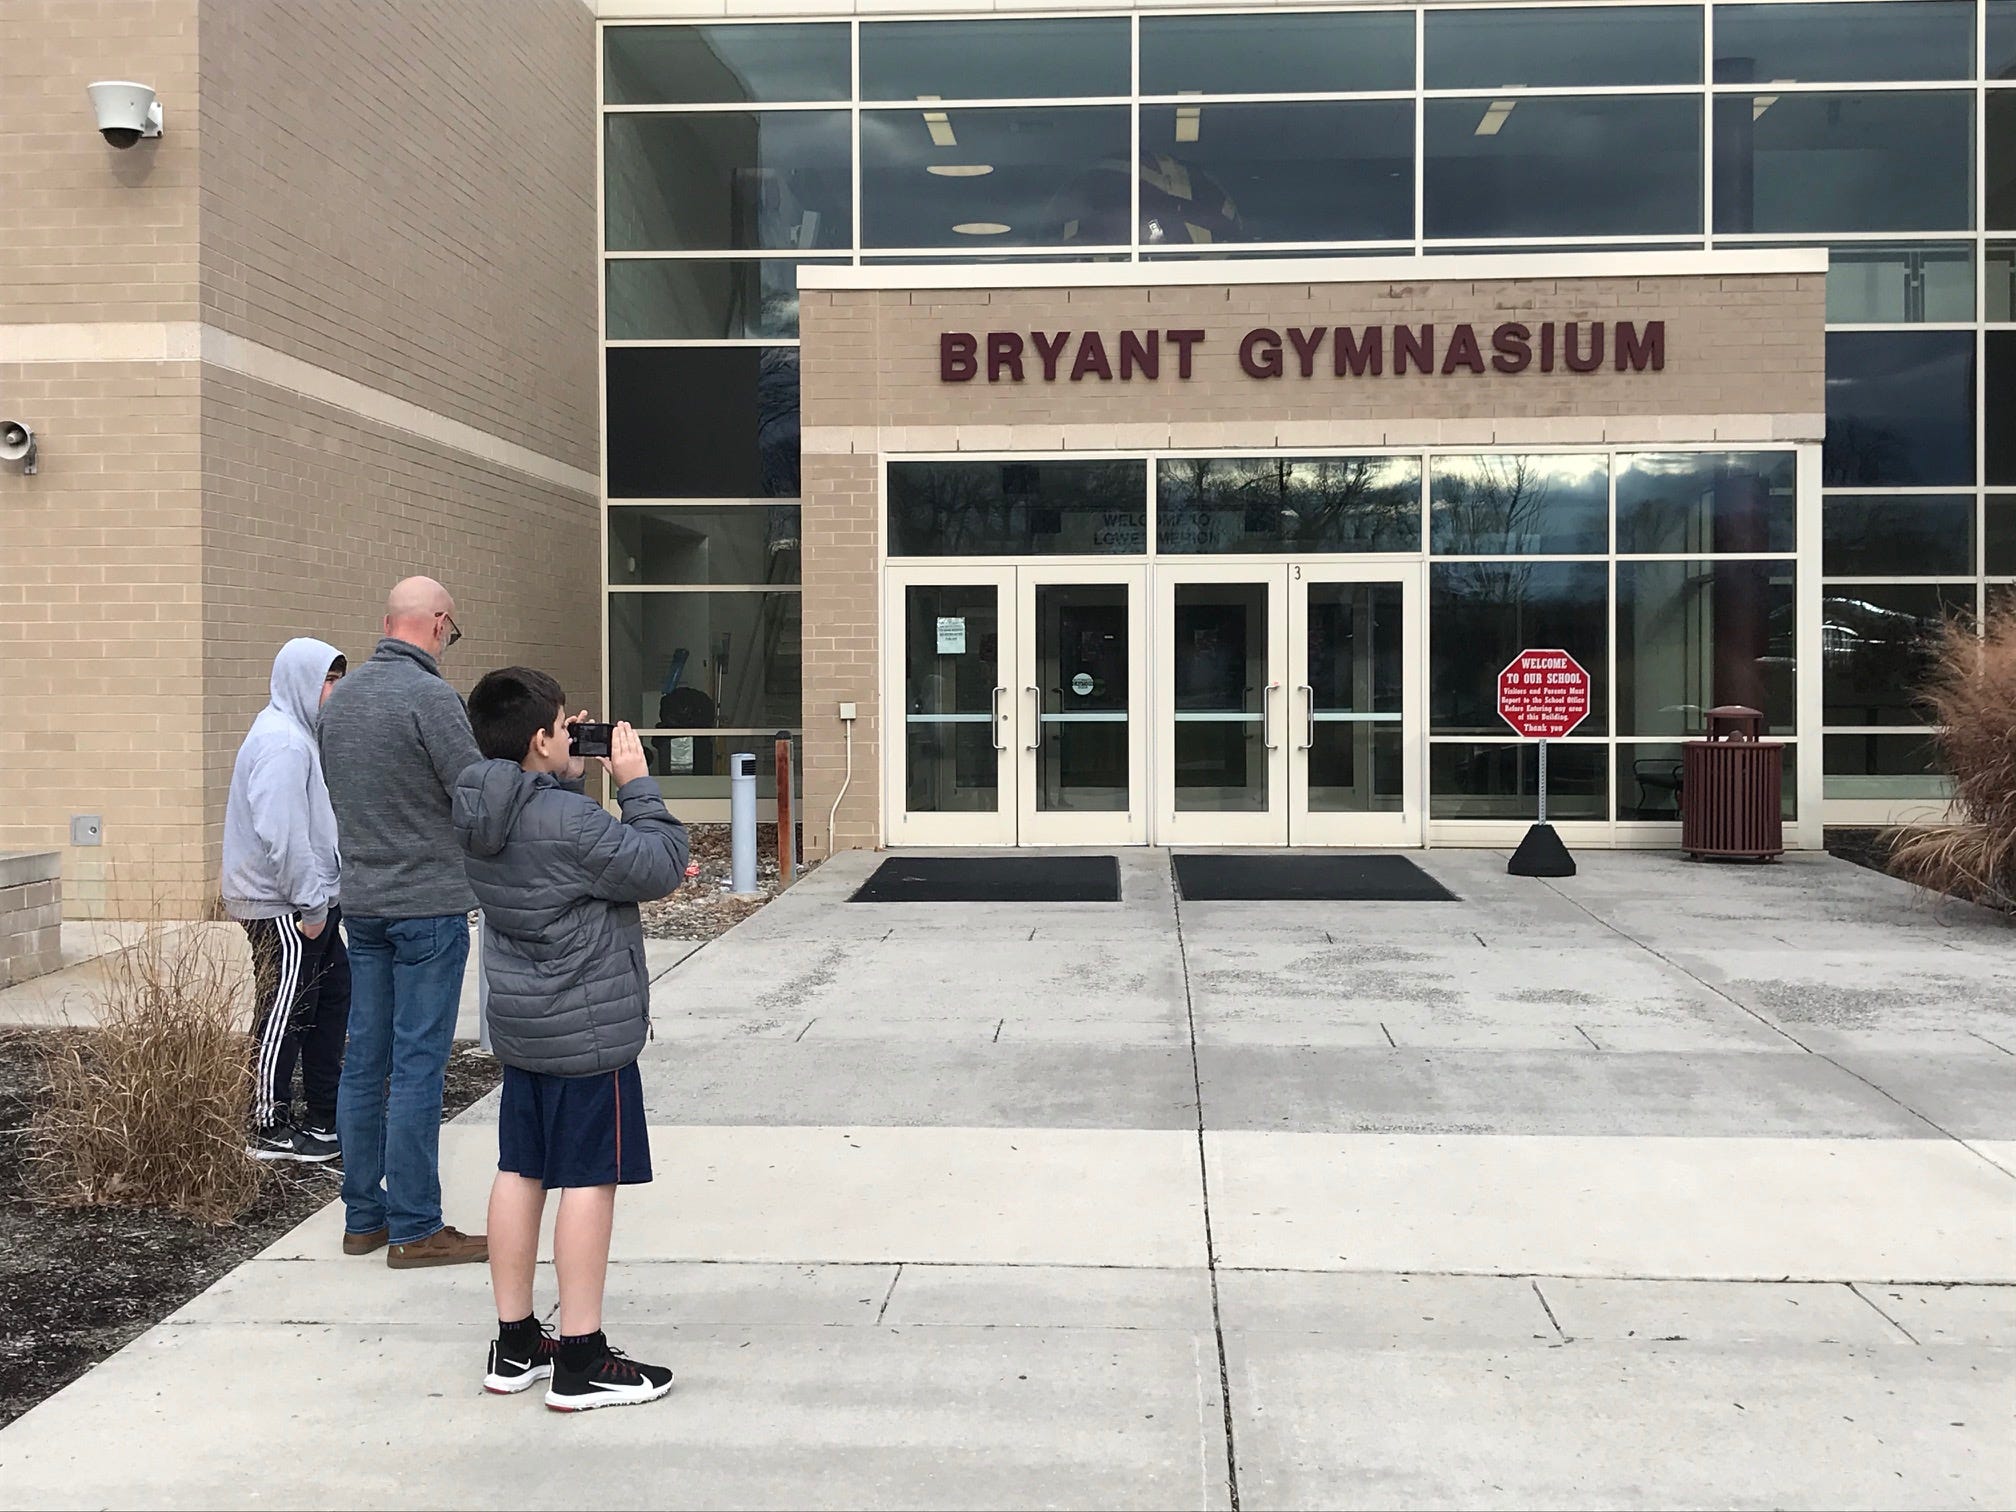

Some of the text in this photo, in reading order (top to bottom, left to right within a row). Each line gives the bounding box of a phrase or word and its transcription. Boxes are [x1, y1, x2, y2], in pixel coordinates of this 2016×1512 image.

[940, 321, 1665, 382] BRYANT GYMNASIUM
[1294, 565, 1301, 580] 3
[1521, 658, 1567, 669] WELCOME
[1506, 673, 1581, 684] TO OUR SCHOOL
[1503, 687, 1584, 695] Visitors and Parents Must
[1501, 696, 1521, 705] Report
[1544, 696, 1565, 704] School
[1566, 696, 1585, 704] Office
[1504, 704, 1524, 712] Before
[1526, 704, 1552, 713] Entering
[1518, 713, 1524, 721] of
[1526, 713, 1539, 721] this
[1524, 723, 1563, 733] Thank you
